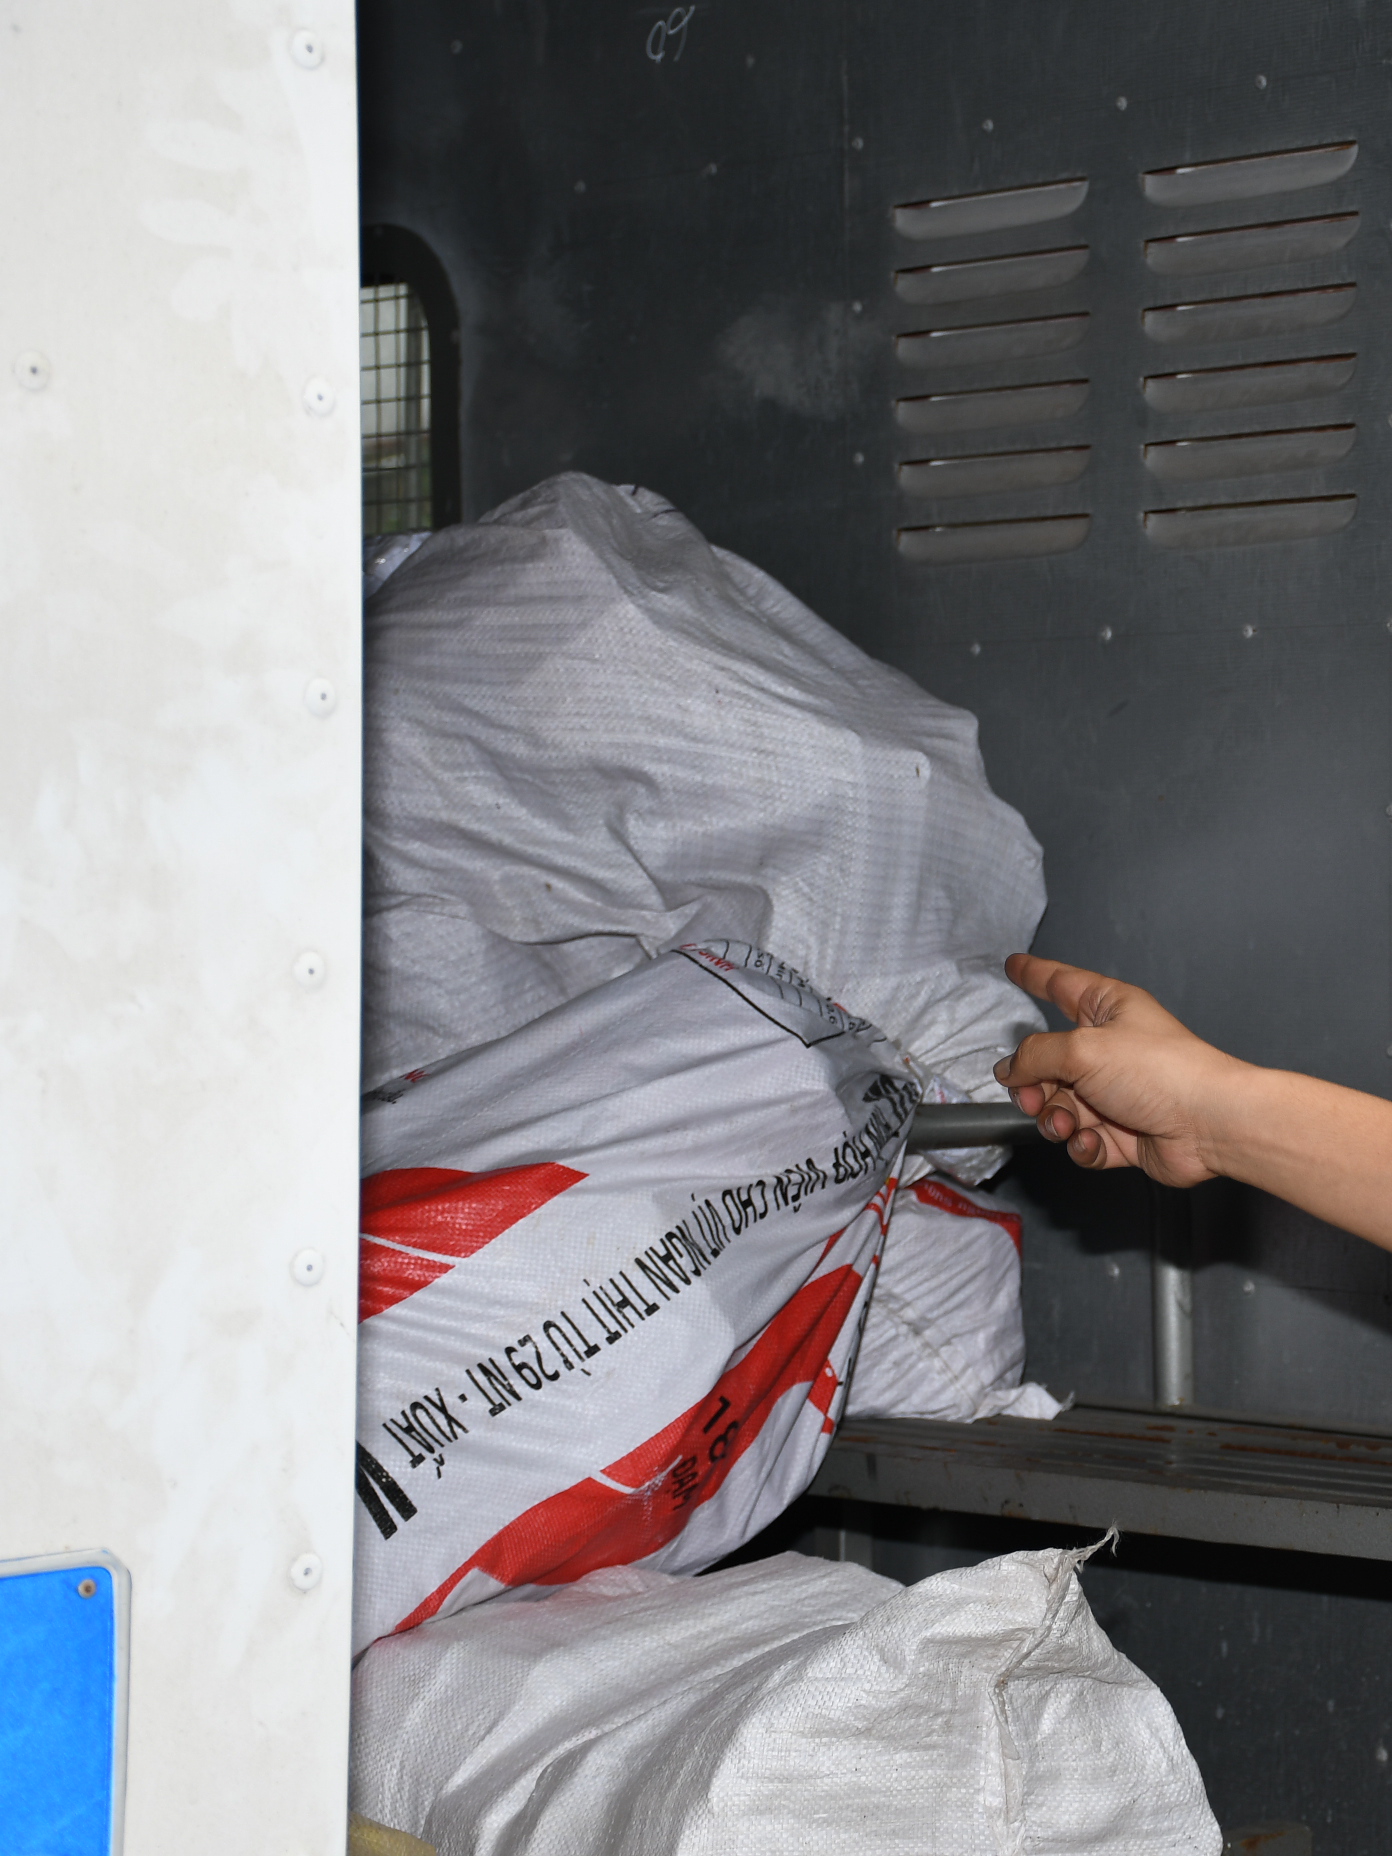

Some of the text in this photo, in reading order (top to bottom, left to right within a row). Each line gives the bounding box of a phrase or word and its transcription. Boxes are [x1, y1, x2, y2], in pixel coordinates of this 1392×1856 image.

[721, 1179, 769, 1236] CHO
[773, 1157, 828, 1214] VIÊN
[690, 1192, 731, 1259] VỊT
[633, 1219, 712, 1301] NGAN
[582, 1270, 661, 1345] THỊT
[464, 1357, 523, 1417] NT
[504, 1333, 561, 1391] 29
[381, 1386, 470, 1479] XUẤT
